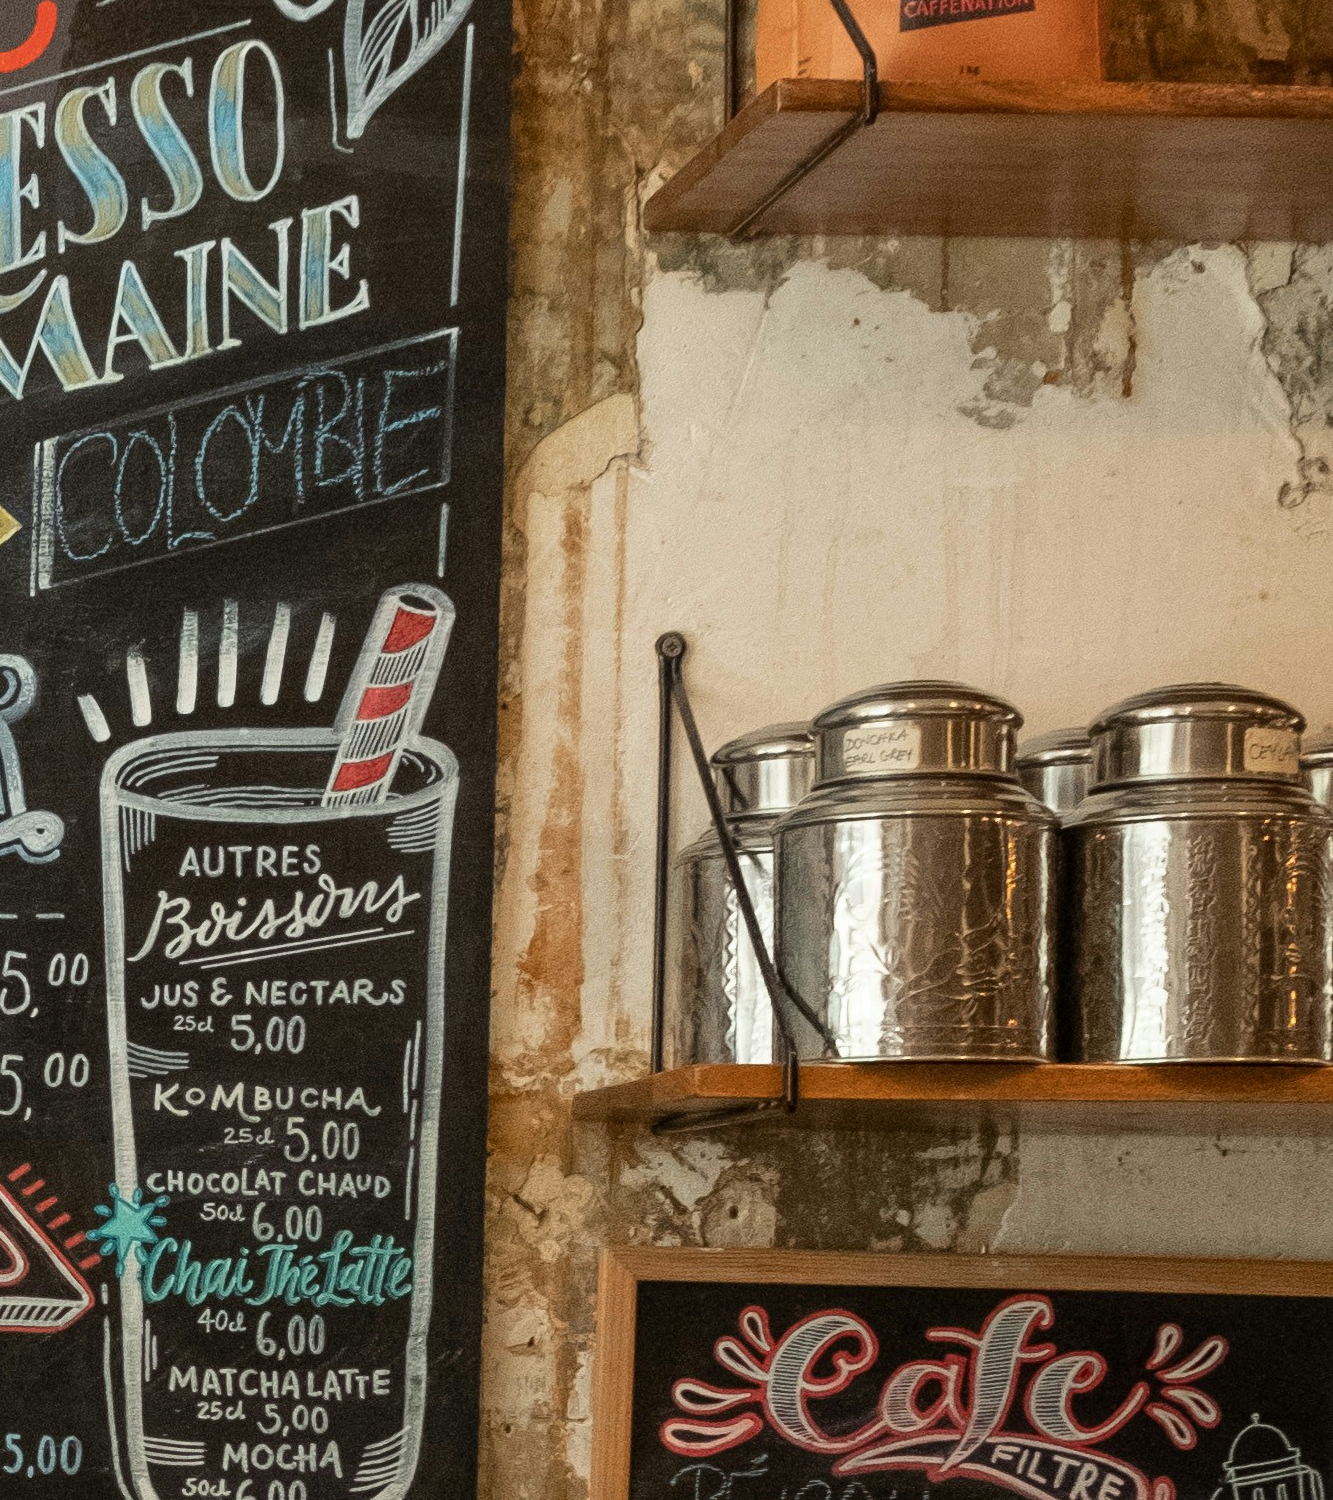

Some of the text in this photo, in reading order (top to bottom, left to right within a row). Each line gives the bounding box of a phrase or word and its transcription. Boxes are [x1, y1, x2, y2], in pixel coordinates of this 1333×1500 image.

[55, 360, 445, 561] COLOMBIE
[179, 845, 321, 876] AUTRES
[128, 874, 421, 962] Boissons
[141, 978, 407, 1008] JUS & NECTARS
[231, 1015, 306, 1053] 5,00
[147, 1169, 391, 1197] CHOCOLAT CHAUD
[141, 1237, 254, 1304] Chai
[318, 1230, 415, 1306] Latte
[169, 1367, 391, 1400] MATCHA LATTE
[222, 1442, 343, 1478] MOCHA
